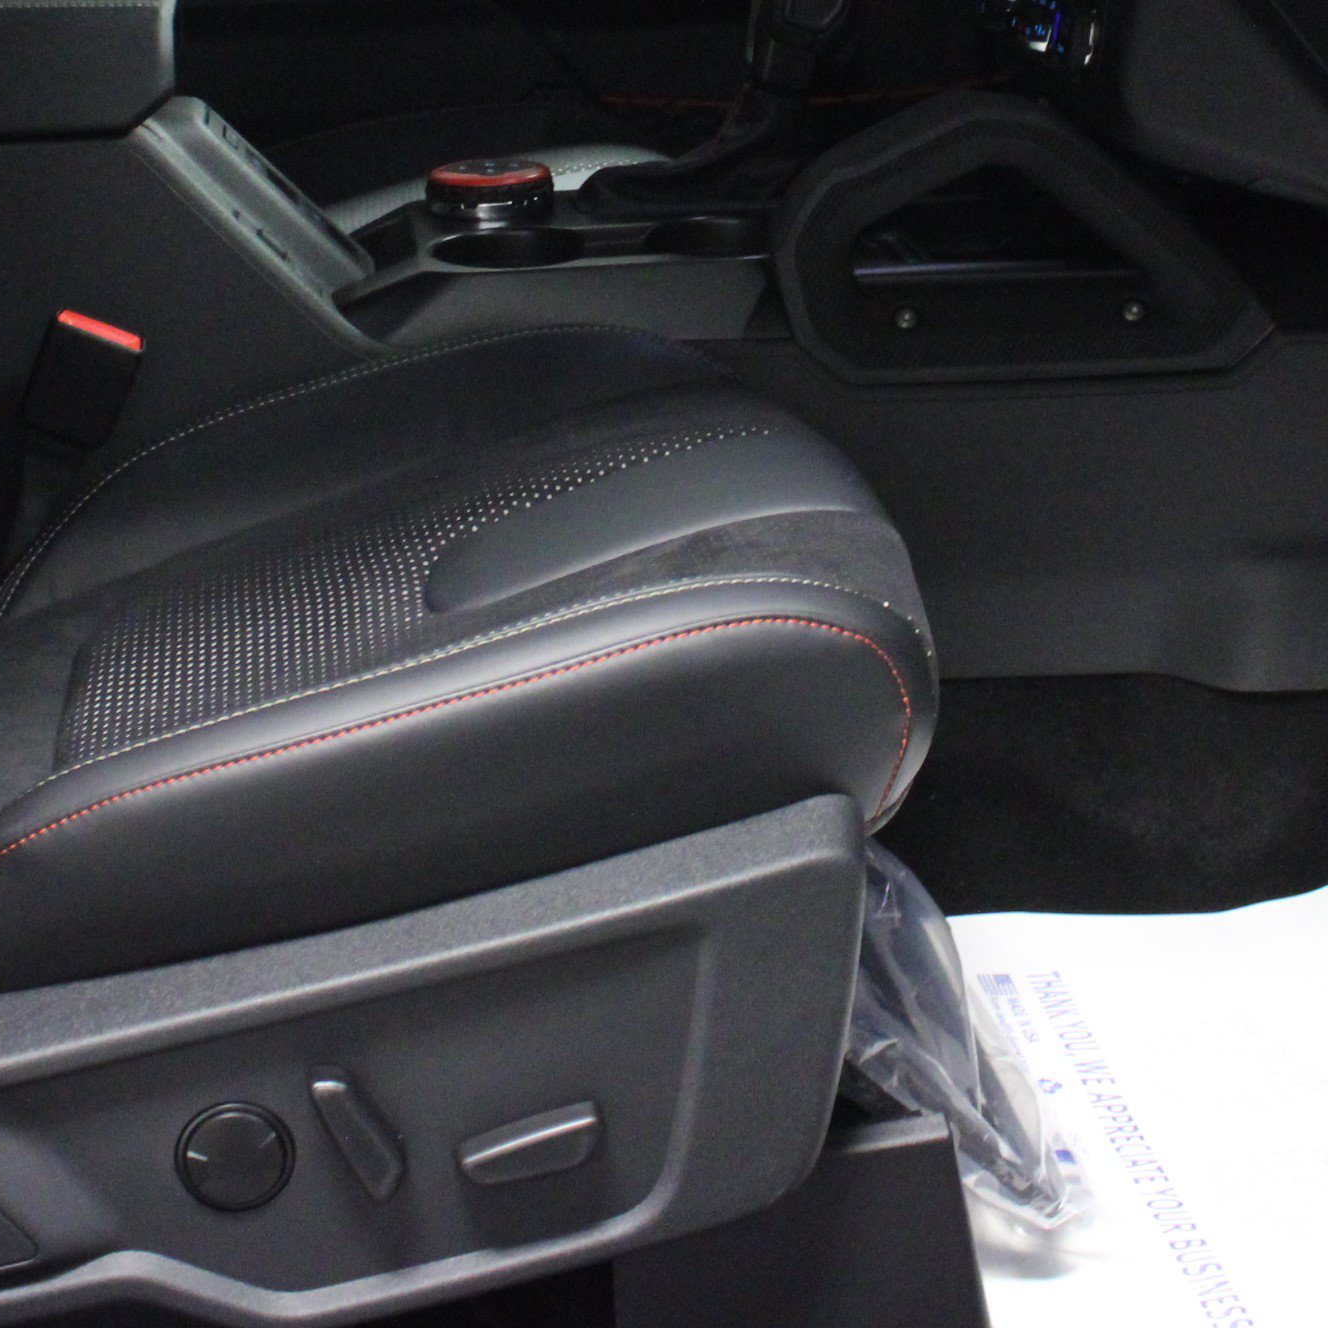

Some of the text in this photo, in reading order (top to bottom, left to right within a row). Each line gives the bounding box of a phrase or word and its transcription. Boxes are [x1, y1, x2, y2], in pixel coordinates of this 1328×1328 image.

[1026, 970, 1081, 1020] THANK
[1073, 1059, 1117, 1086] WE
[1086, 1092, 1170, 1185] APPRECIATE
[1140, 1187, 1198, 1234] YOUR
